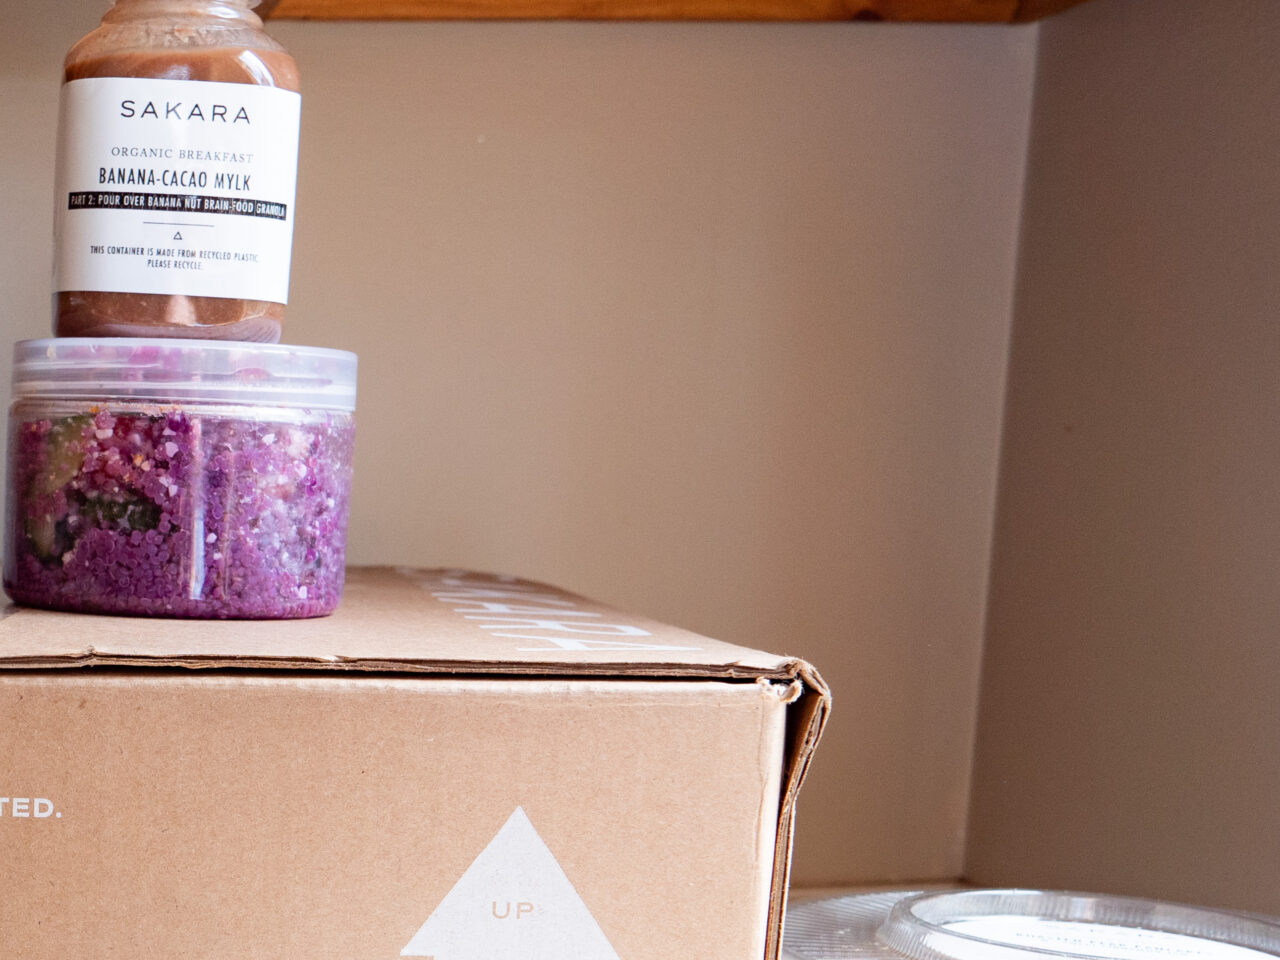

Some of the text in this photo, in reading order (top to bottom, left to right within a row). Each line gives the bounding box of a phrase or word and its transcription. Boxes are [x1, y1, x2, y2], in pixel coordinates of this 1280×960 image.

[120, 100, 251, 124] SAKARA
[111, 147, 254, 164] ORGANIC BREAKFAST
[98, 167, 251, 191] BANANA-CACAO MYLK
[71, 195, 86, 206] PART
[98, 195, 121, 206] POUR
[123, 195, 145, 207] OVER
[147, 196, 182, 208] BANANA
[184, 198, 202, 209] NUT
[204, 199, 254, 213] BRAIN-FOOD
[90, 245, 105, 254] THIS
[107, 246, 145, 256] CONTAINER
[147, 247, 154, 256] IS
[156, 248, 175, 257] MADE
[177, 249, 196, 258] FROM
[199, 250, 232, 261] RECYCLED
[147, 258, 171, 269] PLEASE
[491, 900, 535, 920] UP
